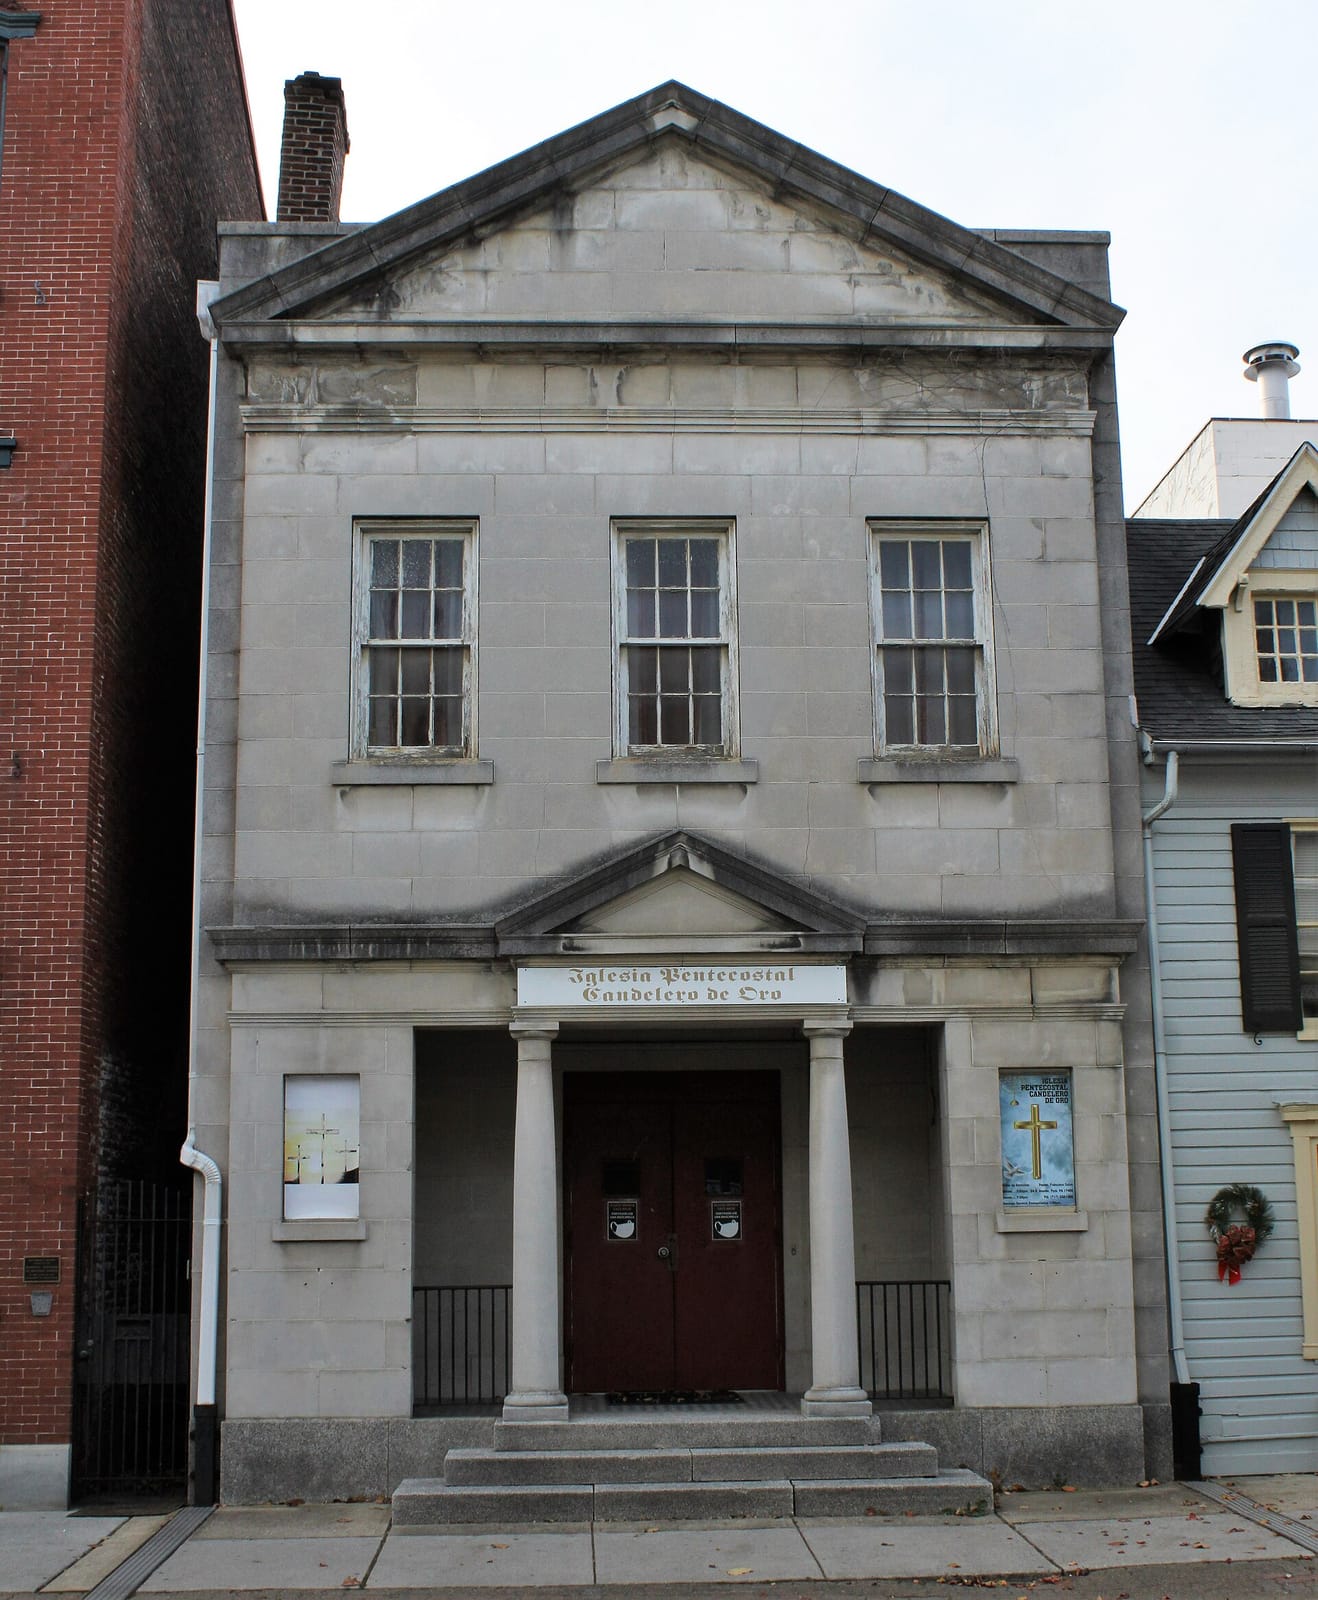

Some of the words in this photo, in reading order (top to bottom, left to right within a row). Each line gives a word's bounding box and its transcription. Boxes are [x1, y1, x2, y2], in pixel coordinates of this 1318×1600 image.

[568, 968, 651, 986] Iglesia
[660, 967, 795, 986] Pentecostal
[582, 987, 698, 1002] Candelero
[707, 987, 729, 1001] de
[737, 986, 782, 1001] Oro
